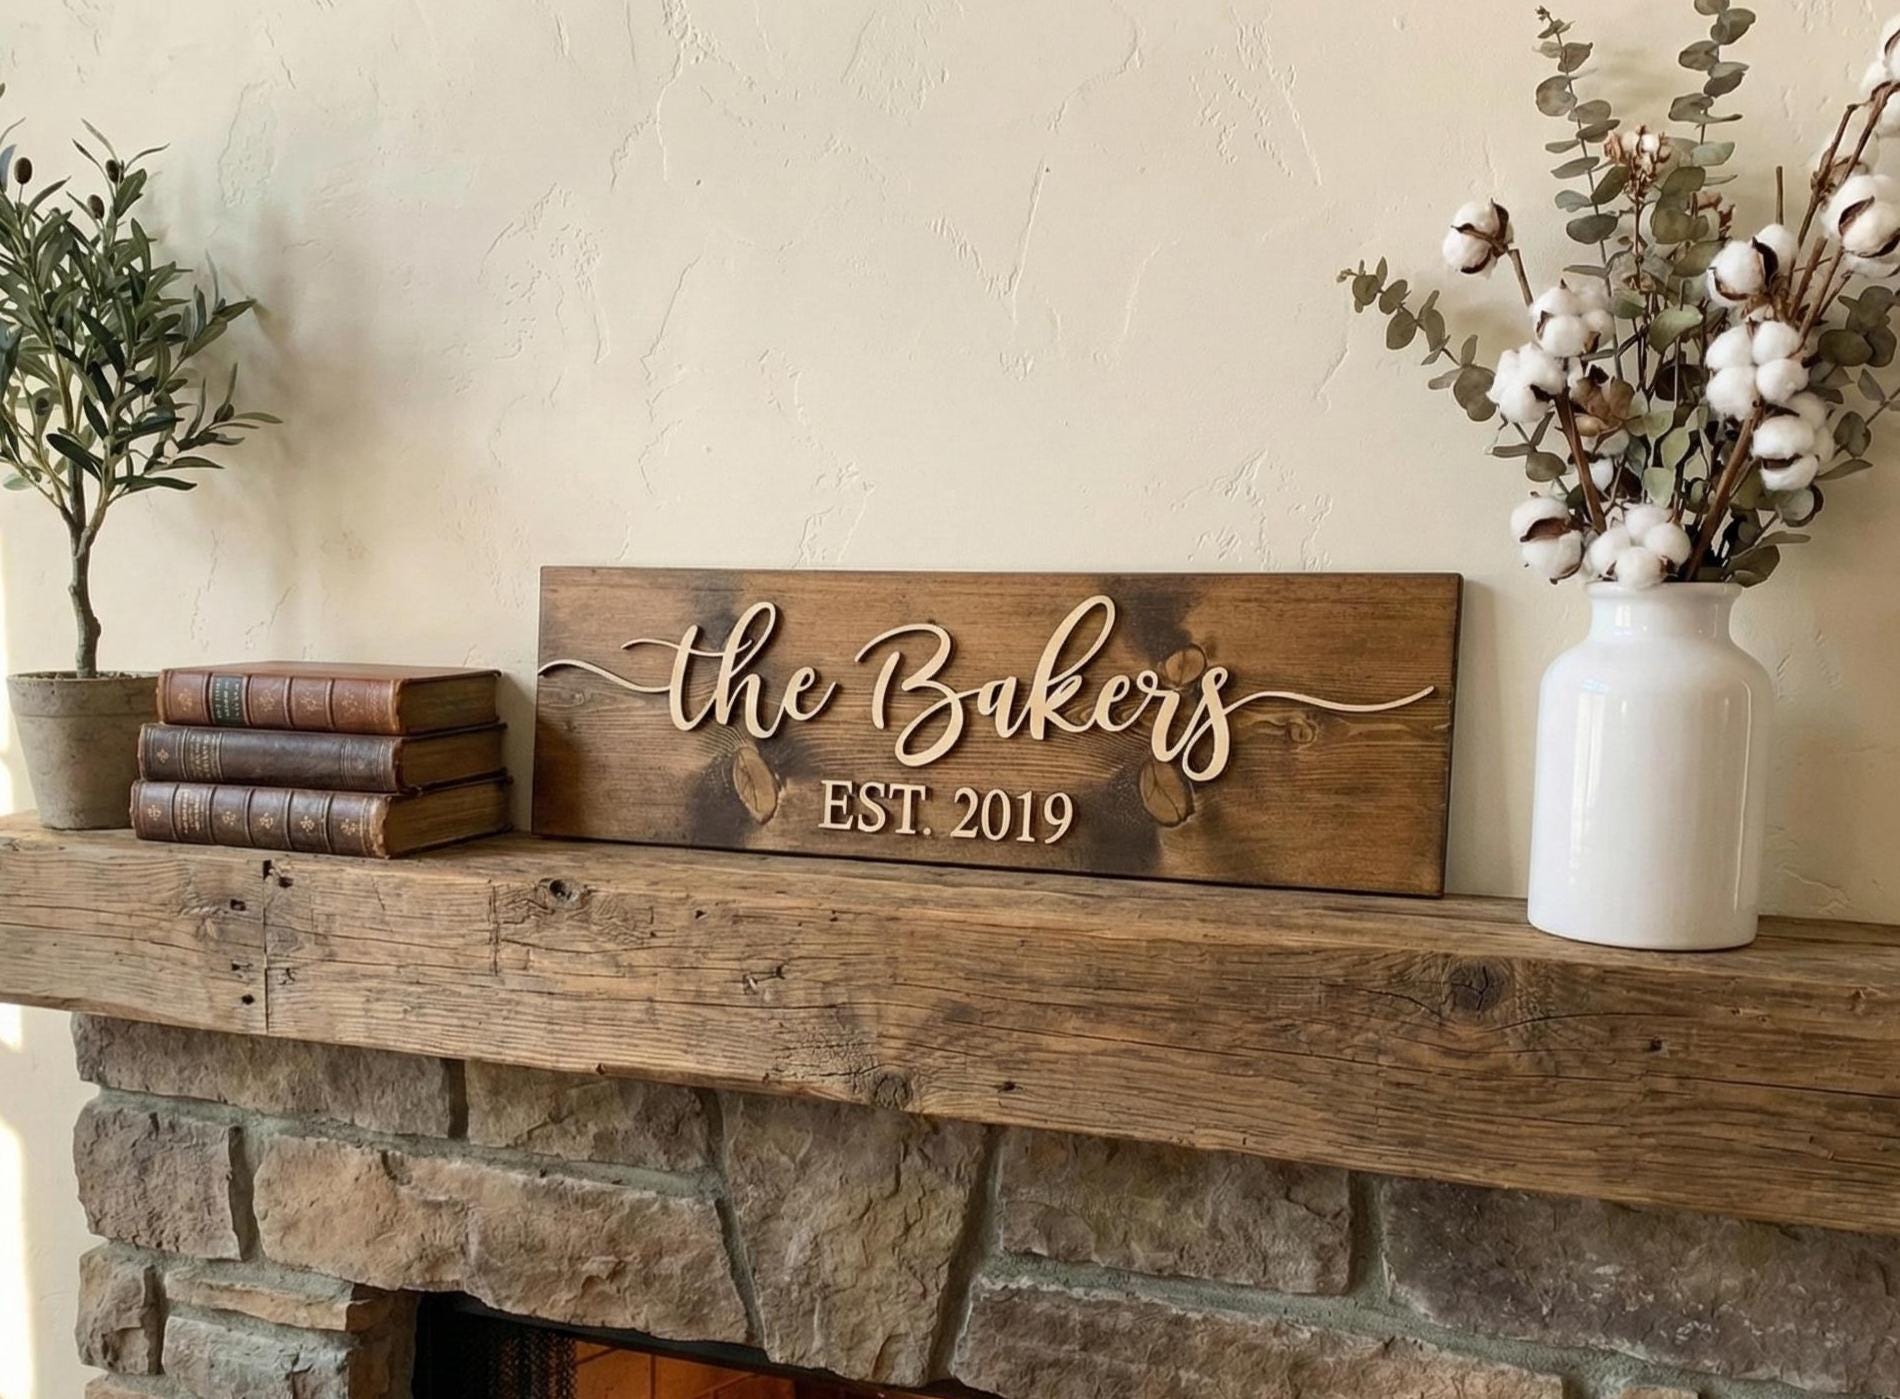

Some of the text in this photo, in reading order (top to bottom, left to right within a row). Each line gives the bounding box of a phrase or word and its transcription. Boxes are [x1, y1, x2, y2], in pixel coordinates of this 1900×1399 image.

[622, 595, 1240, 782] the Bakers
[818, 779, 1074, 844] EST. 2019
